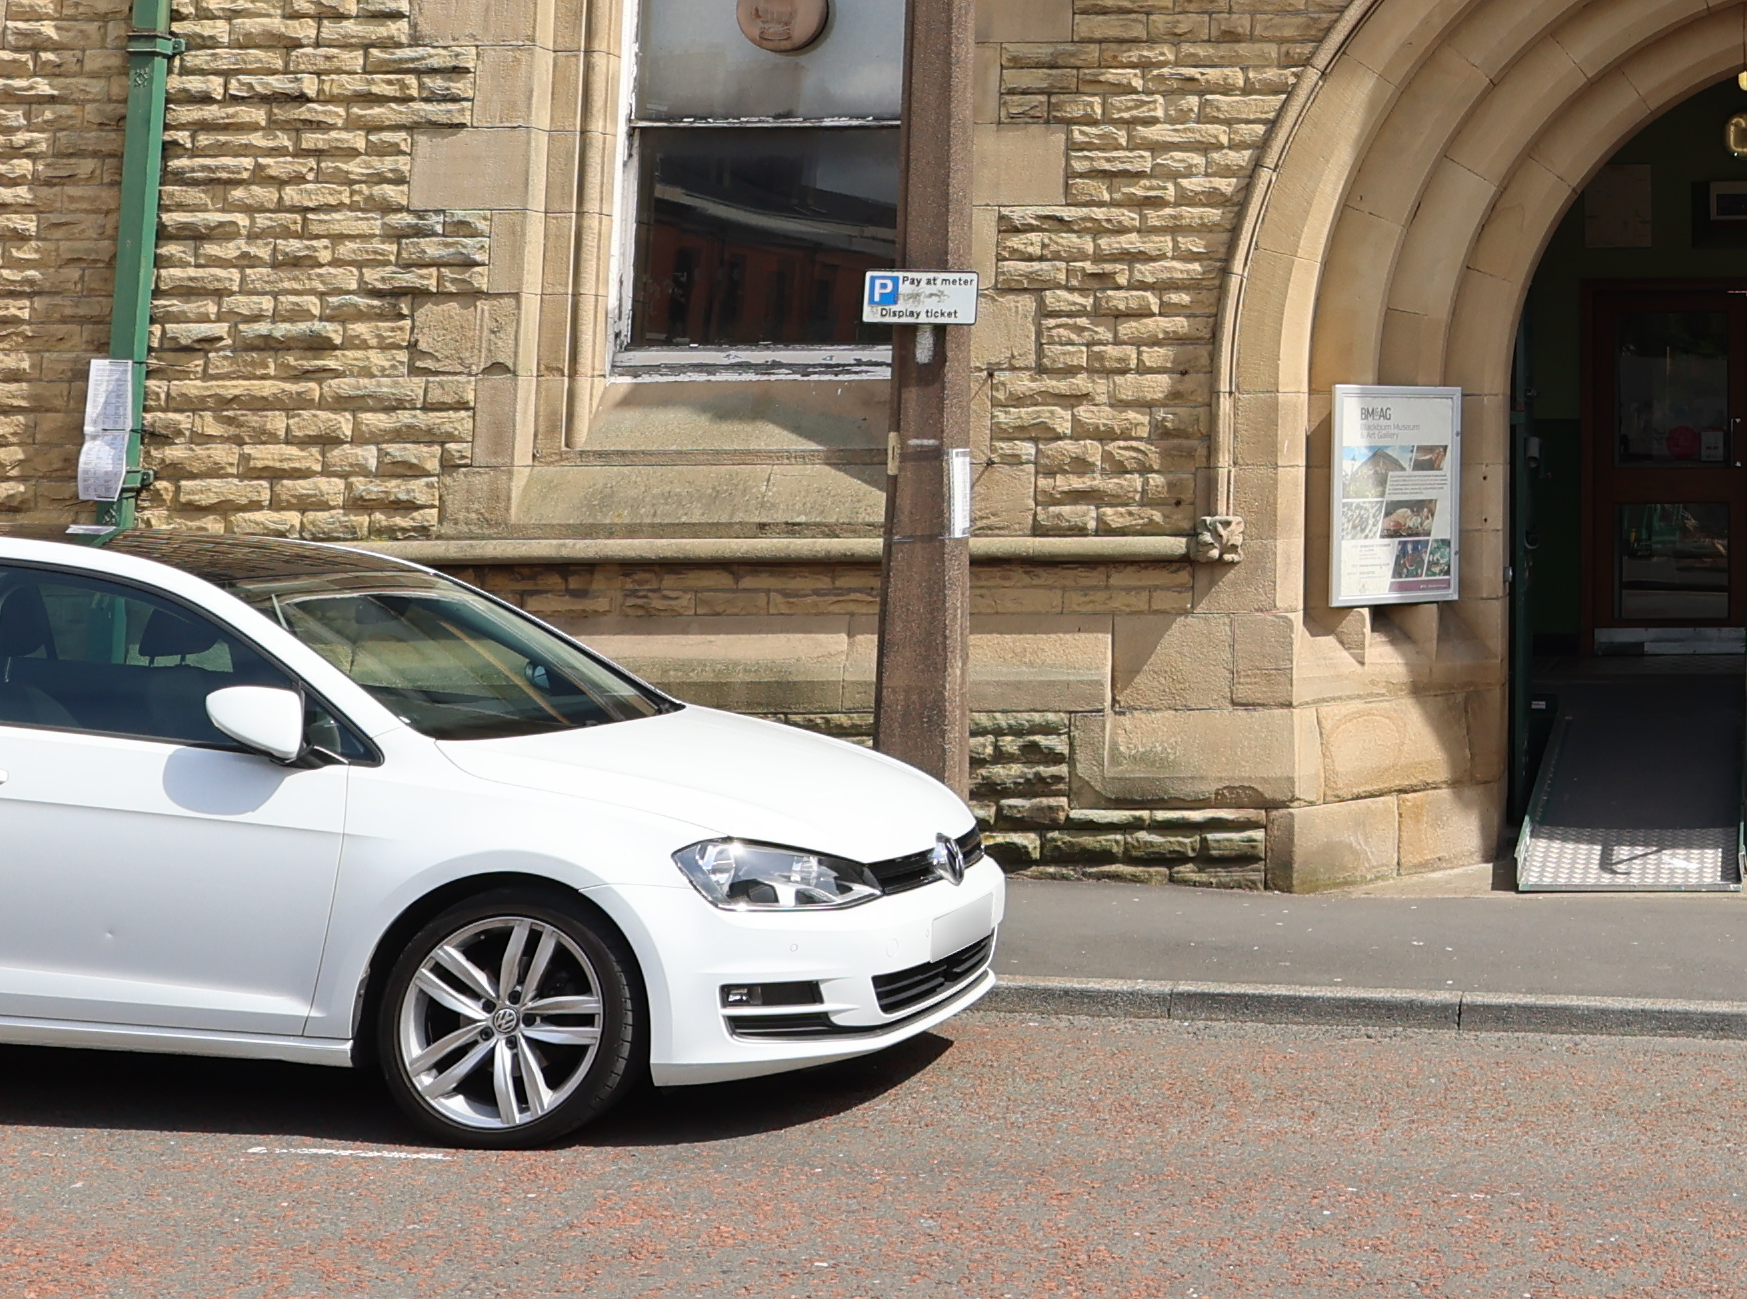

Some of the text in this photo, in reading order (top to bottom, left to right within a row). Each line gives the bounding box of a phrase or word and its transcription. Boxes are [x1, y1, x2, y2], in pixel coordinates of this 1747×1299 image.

[902, 276, 974, 287] Pay at meter
[874, 279, 893, 301] P
[880, 308, 958, 319] Display ticket
[1378, 432, 1399, 440] Gallery
